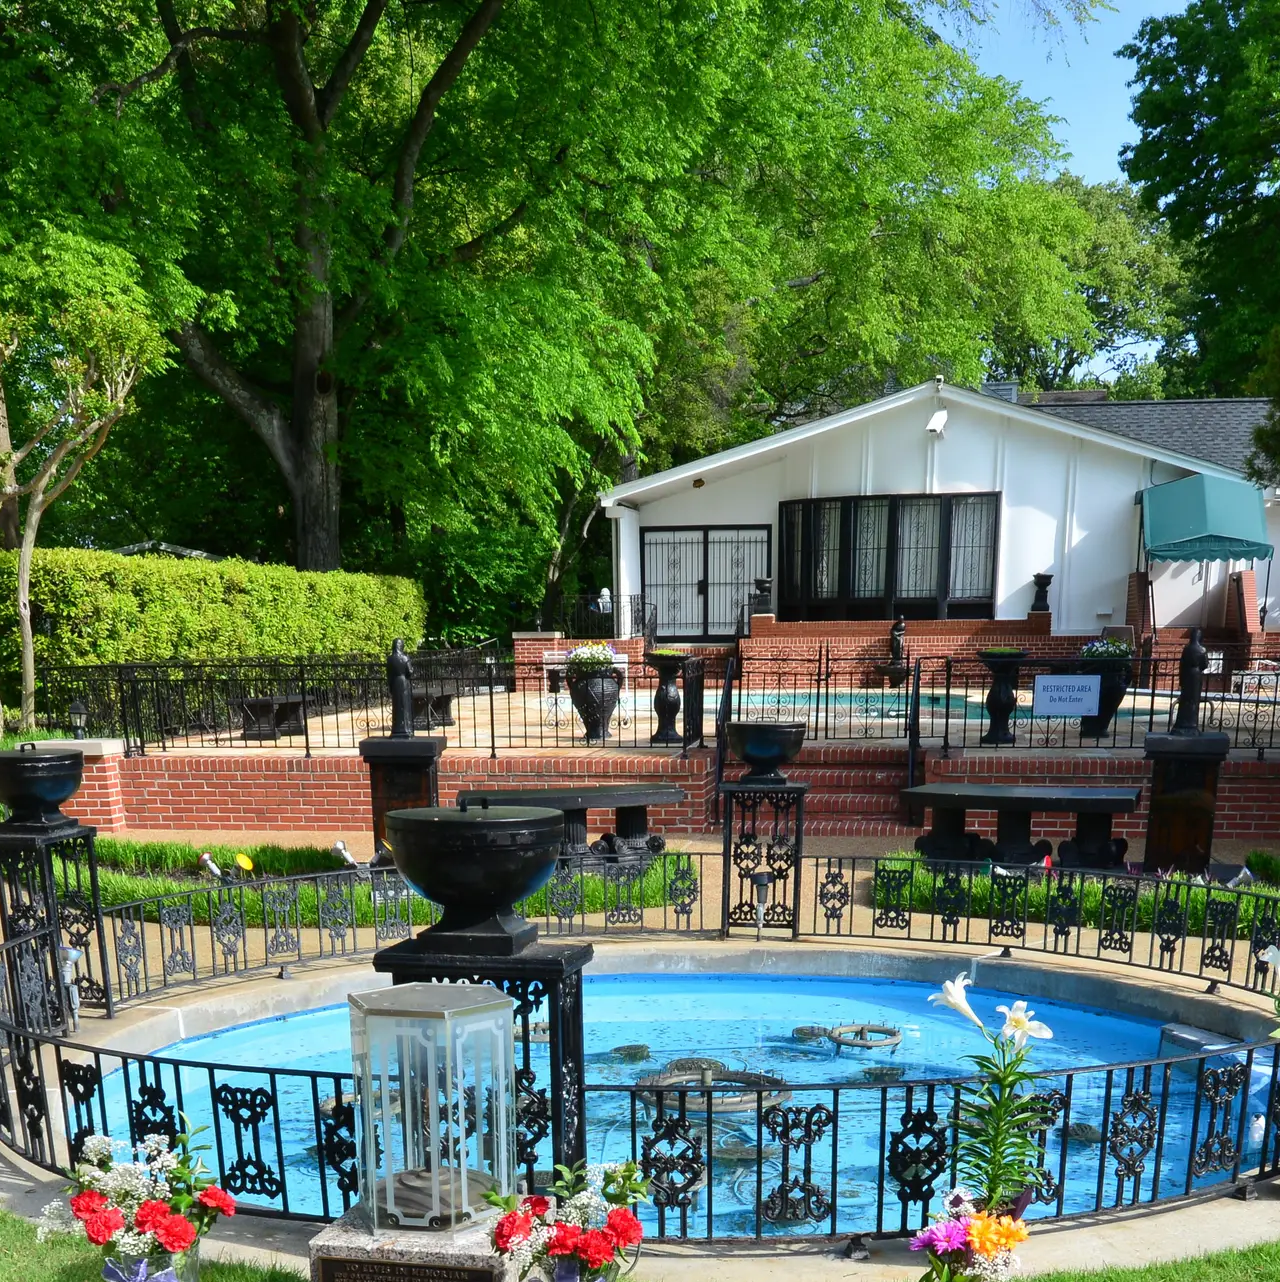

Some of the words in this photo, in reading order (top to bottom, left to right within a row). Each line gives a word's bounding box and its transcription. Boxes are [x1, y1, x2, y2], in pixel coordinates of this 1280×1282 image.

[1042, 685, 1076, 693] RESTRICTED
[1077, 685, 1092, 693] AREA
[1049, 695, 1057, 703] Do
[1058, 695, 1068, 703] Not
[1069, 695, 1083, 703] Enter
[345, 1263, 359, 1272] TO
[363, 1265, 391, 1274] ELVIS
[395, 1267, 407, 1275] IN
[411, 1268, 469, 1280] MEMORIAM
